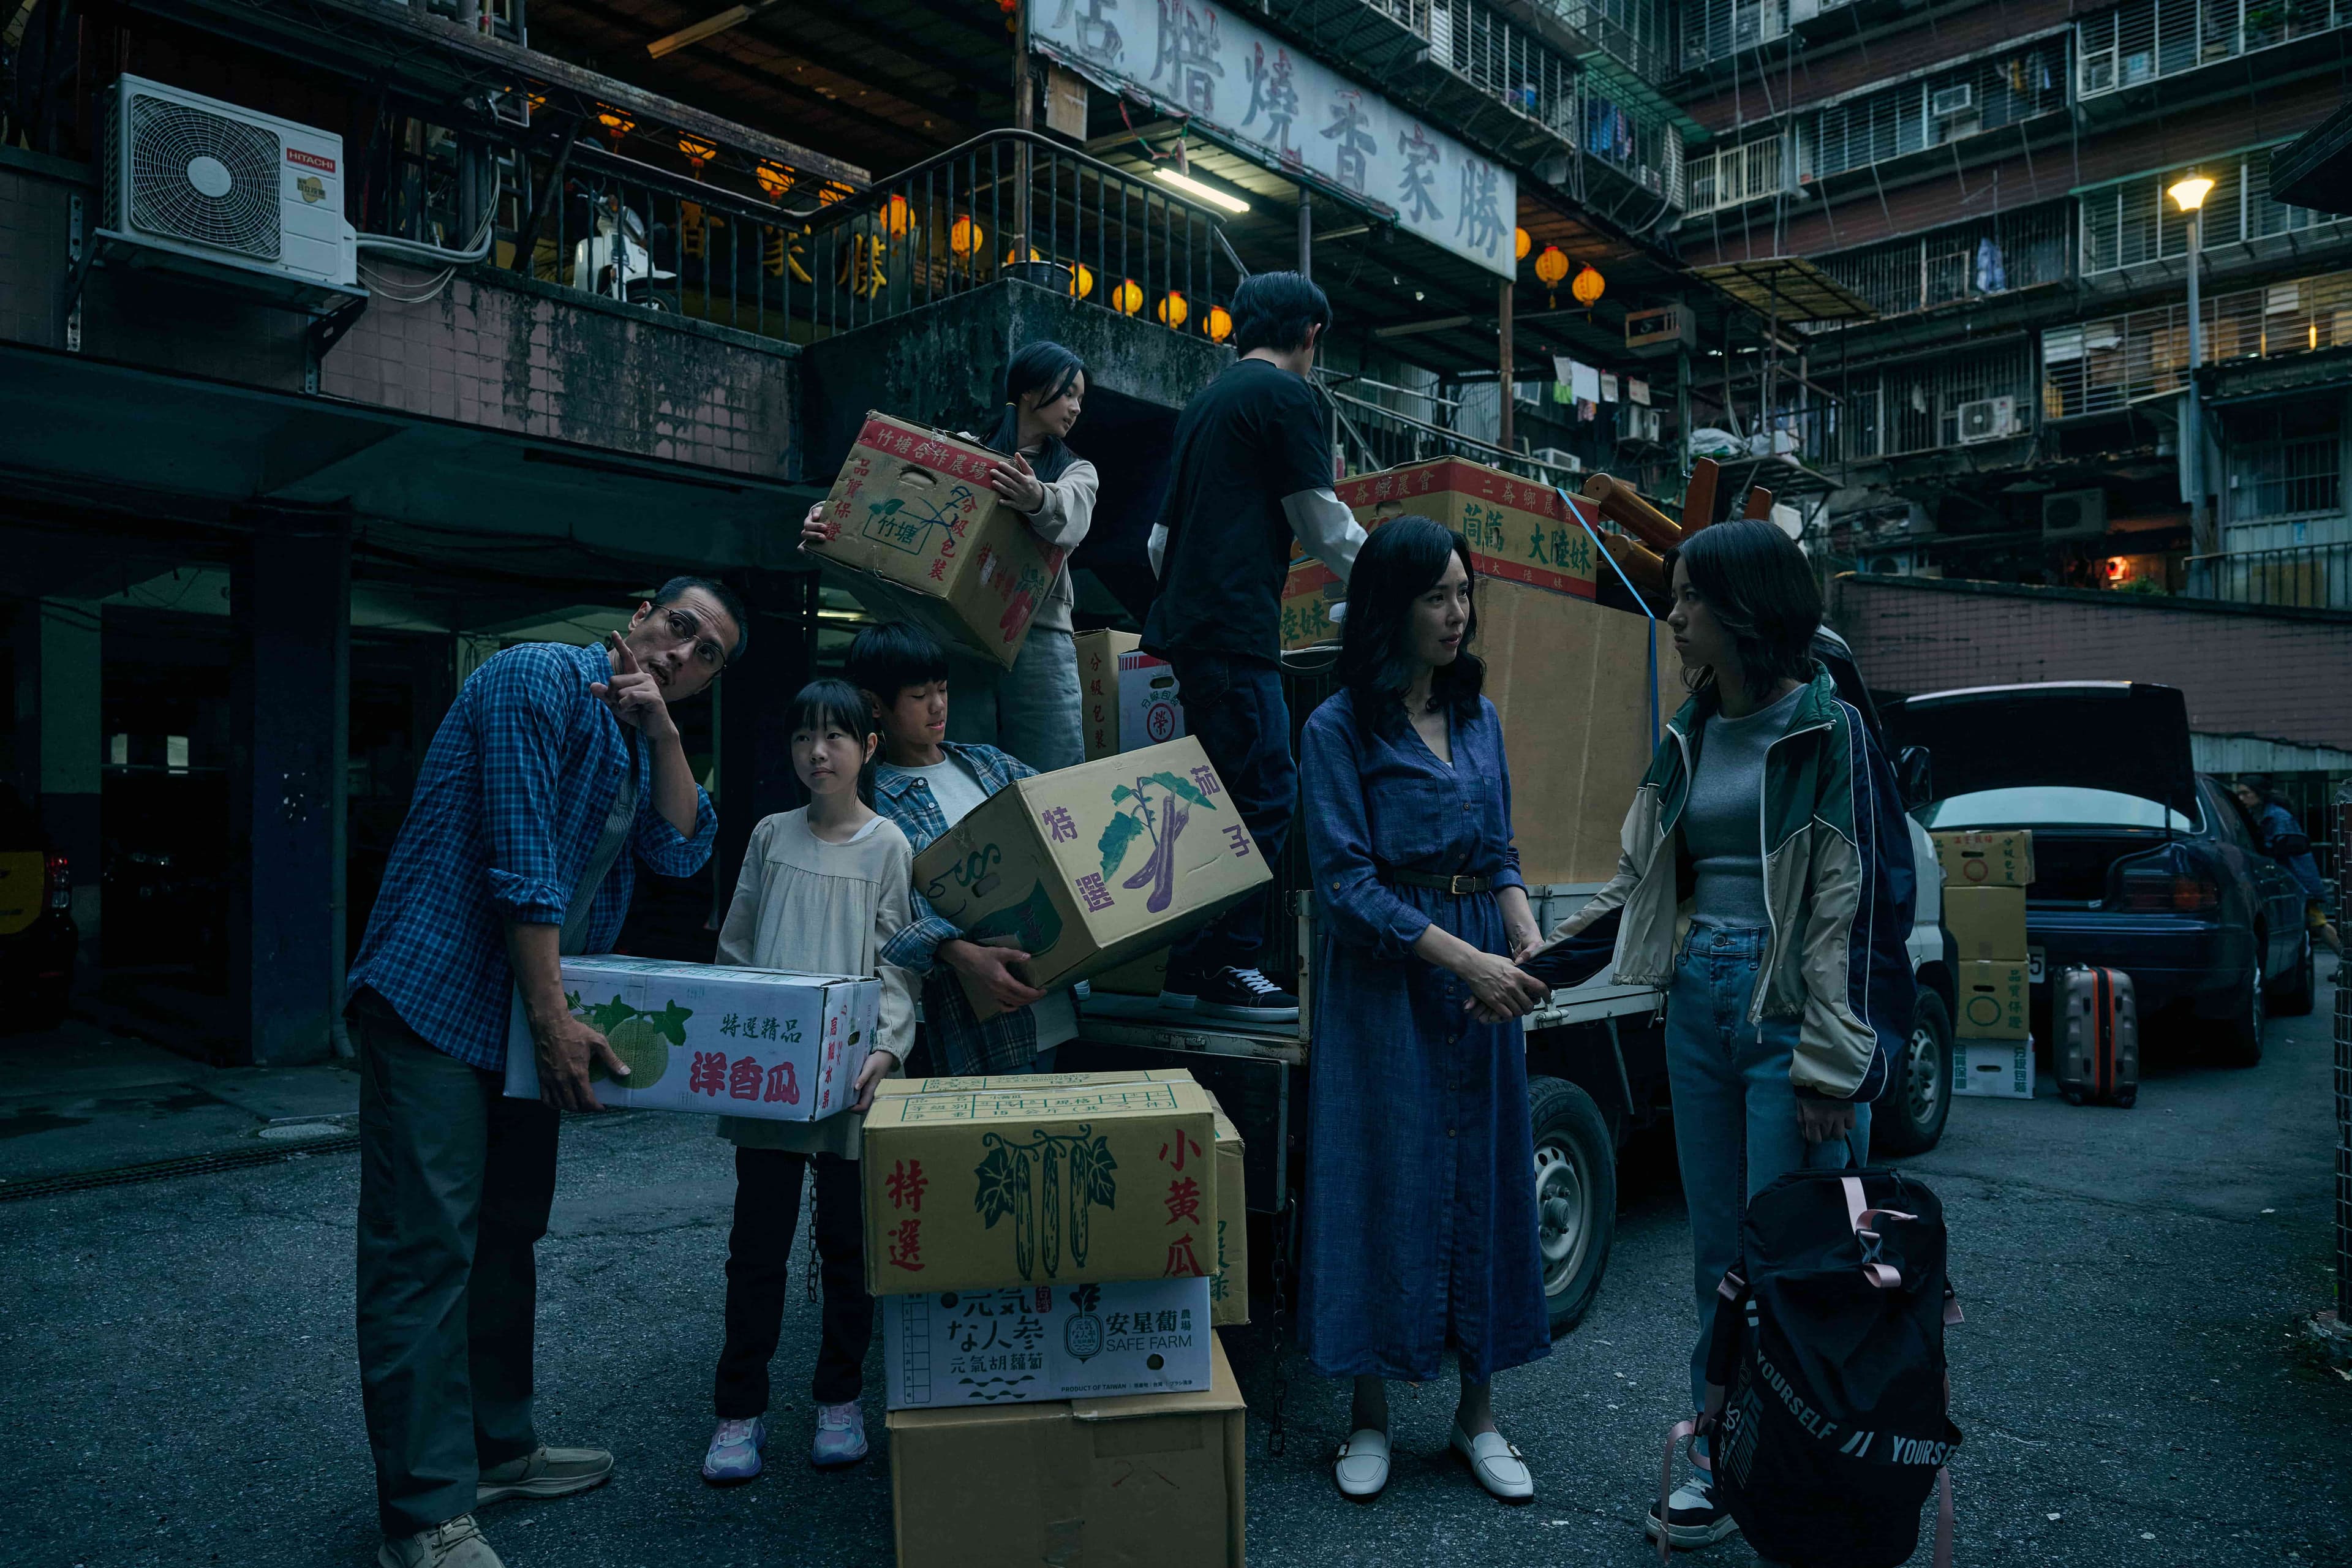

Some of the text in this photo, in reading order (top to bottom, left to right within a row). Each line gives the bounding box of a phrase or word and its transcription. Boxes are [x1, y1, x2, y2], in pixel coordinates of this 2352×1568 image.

[288, 151, 333, 170] HITACHI
[876, 428, 990, 480] 竹塘合作農場
[824, 458, 871, 543] 品質保證
[1482, 480, 1572, 521] 二崙鄉農會
[876, 516, 919, 545] 竹塘
[927, 496, 978, 581] 分級包裝
[1528, 522, 1592, 576] 大陸妹
[1491, 561, 1564, 589] 大陸妹
[1090, 652, 1107, 750] 分級包裝
[1188, 764, 1252, 858] 茄子
[1041, 805, 1115, 914] 特選
[720, 1012, 802, 1044] 特選精品
[688, 1050, 801, 1106] 洋香瓜
[884, 1159, 929, 1273] 特選
[1159, 1128, 1205, 1278] 小黃瓜
[1106, 1335, 1192, 1352] SAFE FARM
[1180, 1308, 1191, 1332] 農場
[1757, 1348, 1838, 1440] YOURSELF
